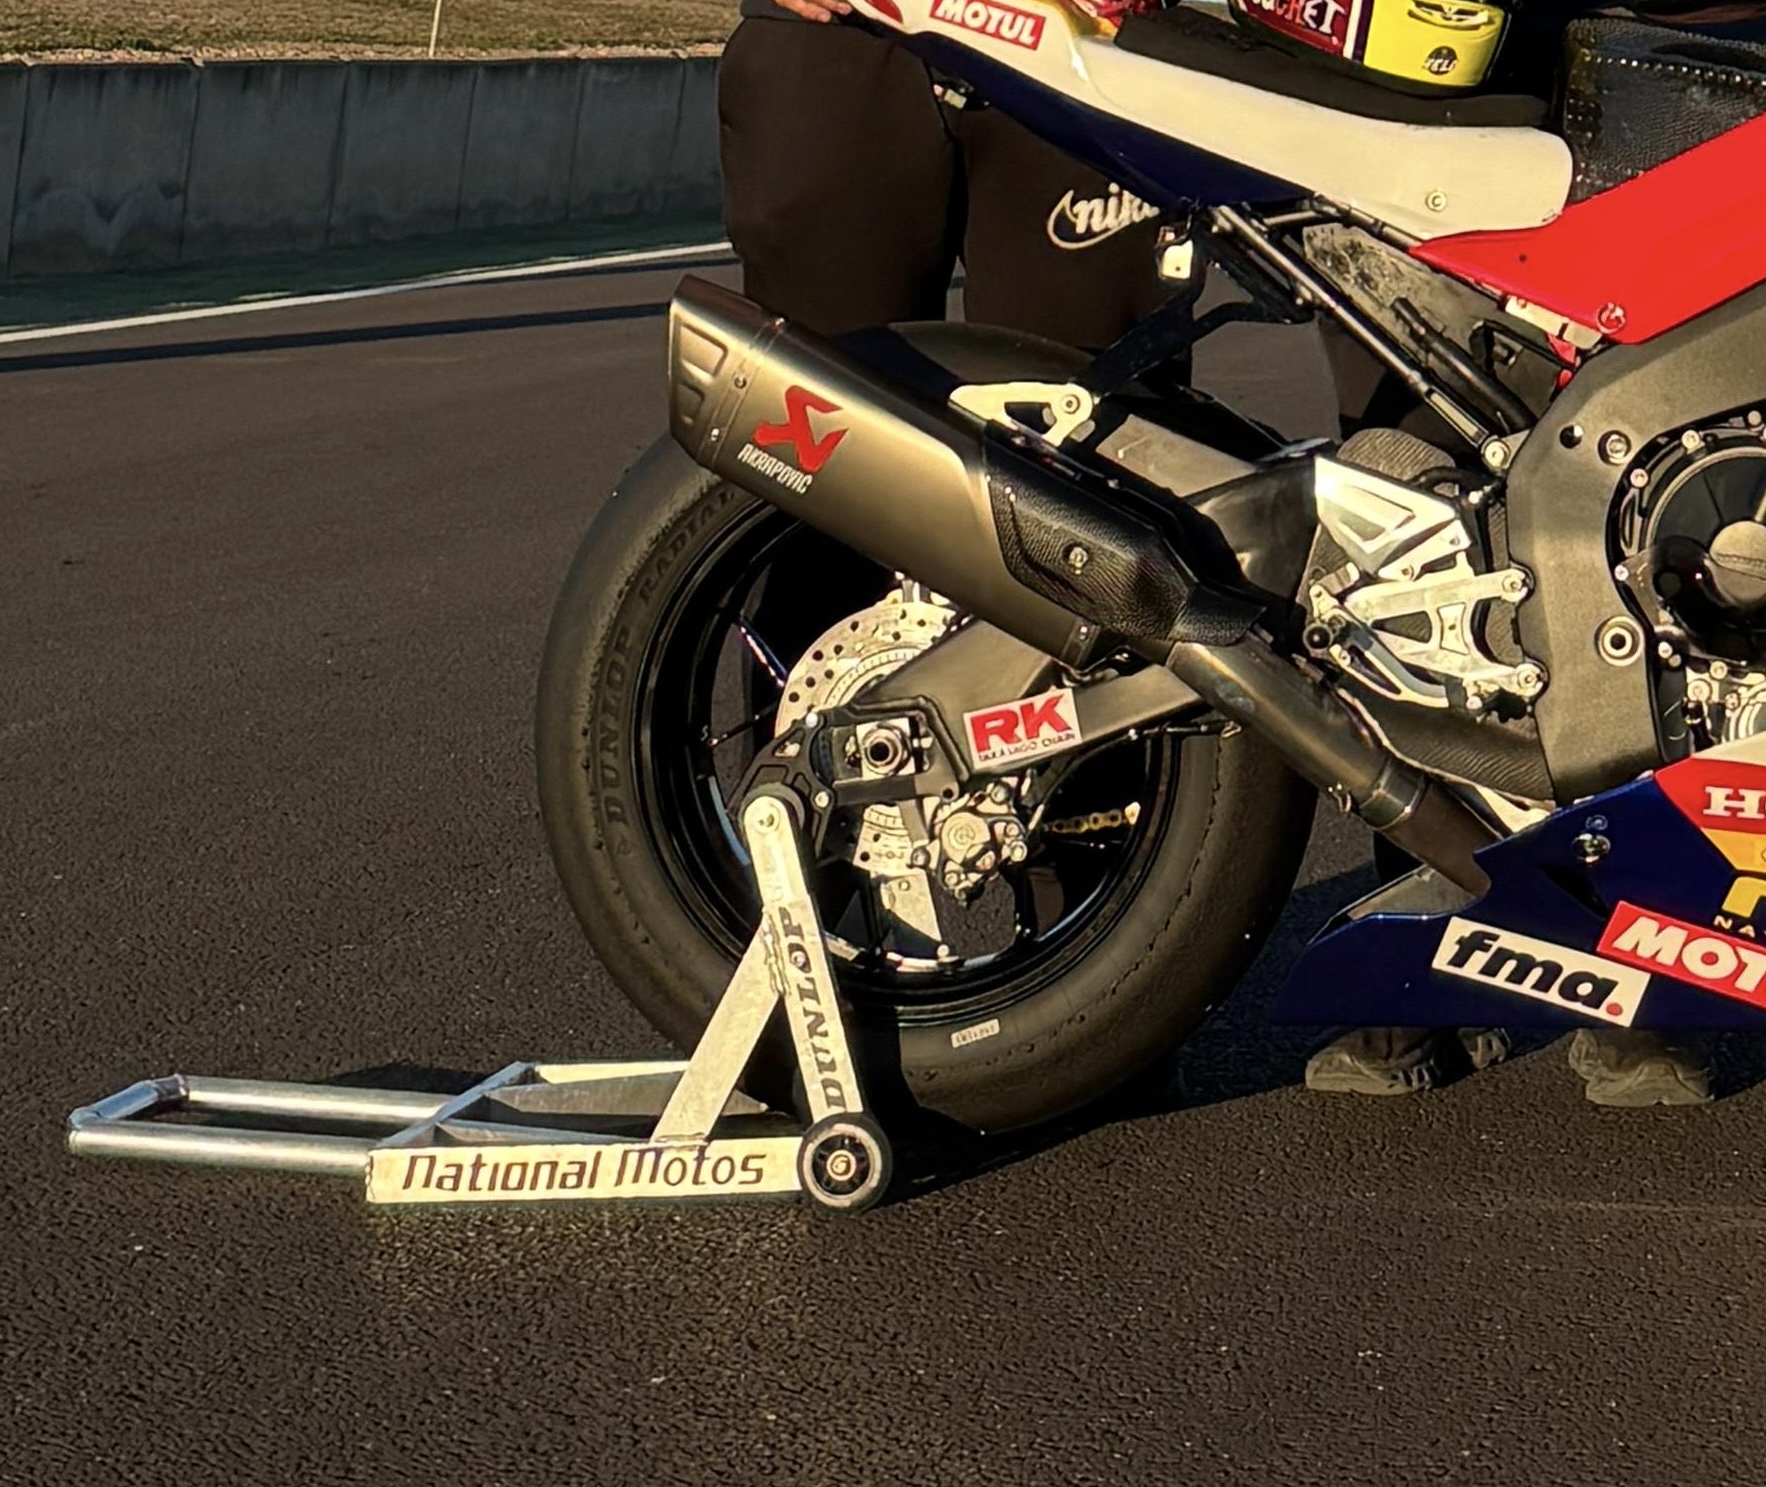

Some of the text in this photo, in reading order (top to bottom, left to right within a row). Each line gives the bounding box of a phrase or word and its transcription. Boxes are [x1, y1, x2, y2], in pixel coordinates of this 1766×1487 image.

[970, 693, 1073, 753] RK
[778, 906, 847, 1113] DUNLOP
[1447, 929, 1624, 1018] fma.
